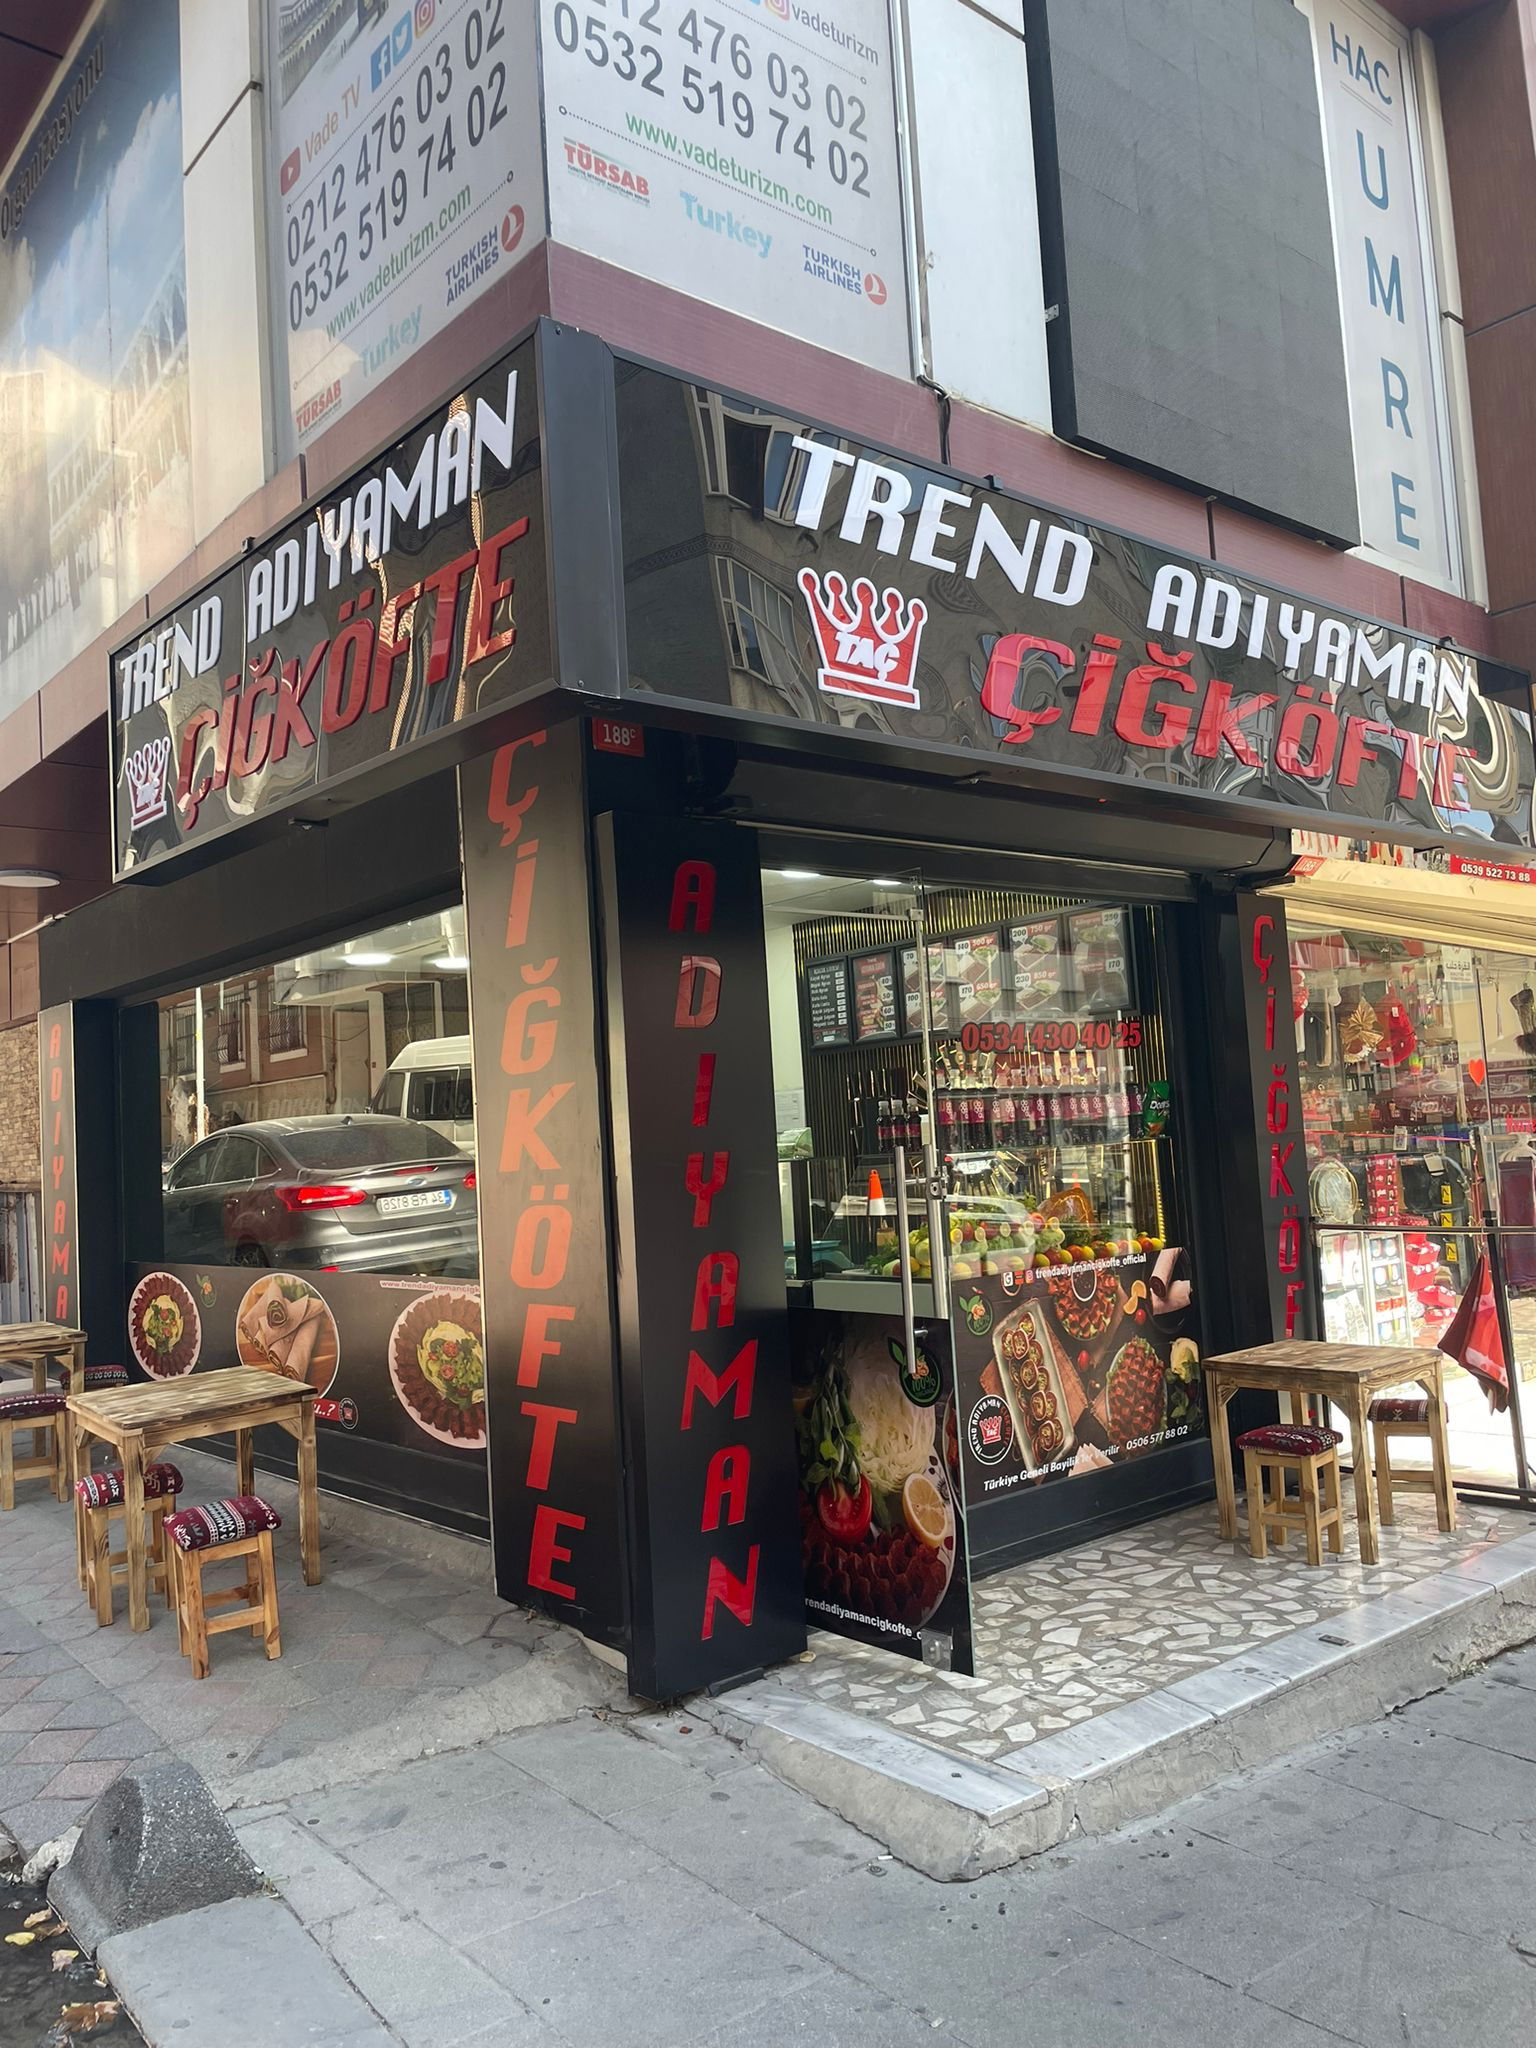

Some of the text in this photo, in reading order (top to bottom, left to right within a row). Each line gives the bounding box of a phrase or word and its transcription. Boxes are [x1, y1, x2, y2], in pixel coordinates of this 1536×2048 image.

[678, 9, 752, 80] 476
[767, 52, 811, 111] 03
[826, 84, 868, 142] 02
[792, 3, 879, 66] vadeturizm
[1330, 22, 1393, 106] HAC
[288, 0, 505, 267] 0212 476 03 02
[304, 74, 361, 163] Vade TV
[553, 2, 664, 97] 0532
[682, 64, 754, 138] 519
[768, 107, 815, 169] 74
[828, 140, 871, 198] 02
[289, 61, 507, 332] 0532 519 74 02
[563, 142, 650, 196] TÜRSAB
[626, 112, 832, 225] www.vadeturizm.com
[326, 185, 471, 342] www.vadeturizm.com
[445, 226, 498, 286] TURKISH
[680, 190, 773, 259] Turkey
[803, 245, 861, 281] TURKISH
[446, 246, 499, 307] AIRLINES
[804, 260, 862, 296] AIRLINES
[360, 304, 422, 377] Turkey
[1356, 129, 1421, 552] UMRE
[295, 379, 342, 433] TÜRSAB
[120, 370, 518, 721] TREND ADIYAMAN
[791, 435, 1472, 720] TREND ADIYAMAN
[176, 516, 529, 830] ÇİĞKÖFTE
[980, 632, 1478, 813] ÇİĞKÖFTE
[1461, 863, 1531, 882] 0539 522 73 88
[961, 1020, 1143, 1052] 0534 430 40 25
[487, 729, 587, 1601] ÇİĞKÖFTE
[1253, 914, 1304, 1338] ÇİĞKÖF
[49, 1023, 70, 1320] ADIYAMA
[381, 1281, 480, 1292] www.trendadiyamancigk
[668, 859, 761, 1641] ADIYAMAN
[984, 1473, 1019, 1491] Türkiye
[1019, 1463, 1049, 1480] Geneli
[1126, 1425, 1189, 1450] 0506 577 88 02
